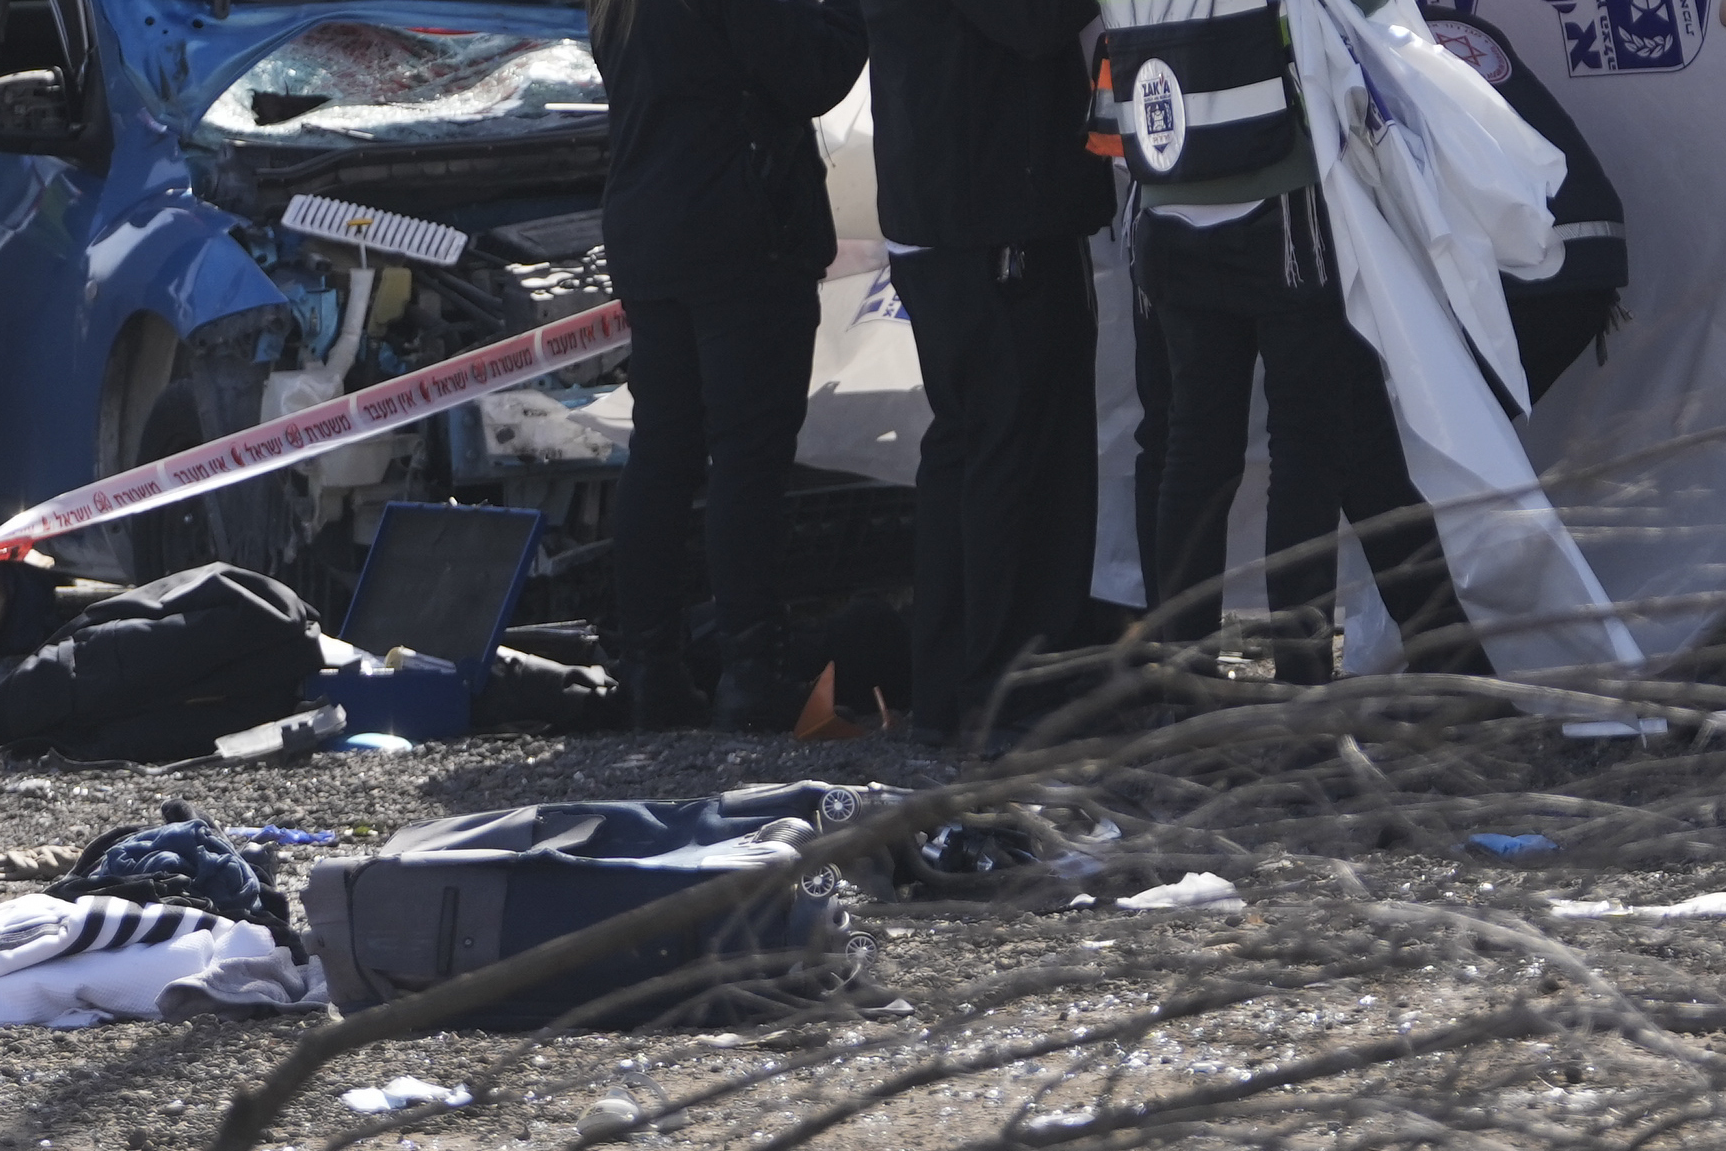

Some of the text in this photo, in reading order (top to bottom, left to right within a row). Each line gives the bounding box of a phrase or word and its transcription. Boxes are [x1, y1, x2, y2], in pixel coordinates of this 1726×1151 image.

[547, 325, 598, 358] אין מעבר
[362, 348, 534, 423] משטרת ישראל אין מעבר
[243, 412, 352, 464] משטרת ישראל
